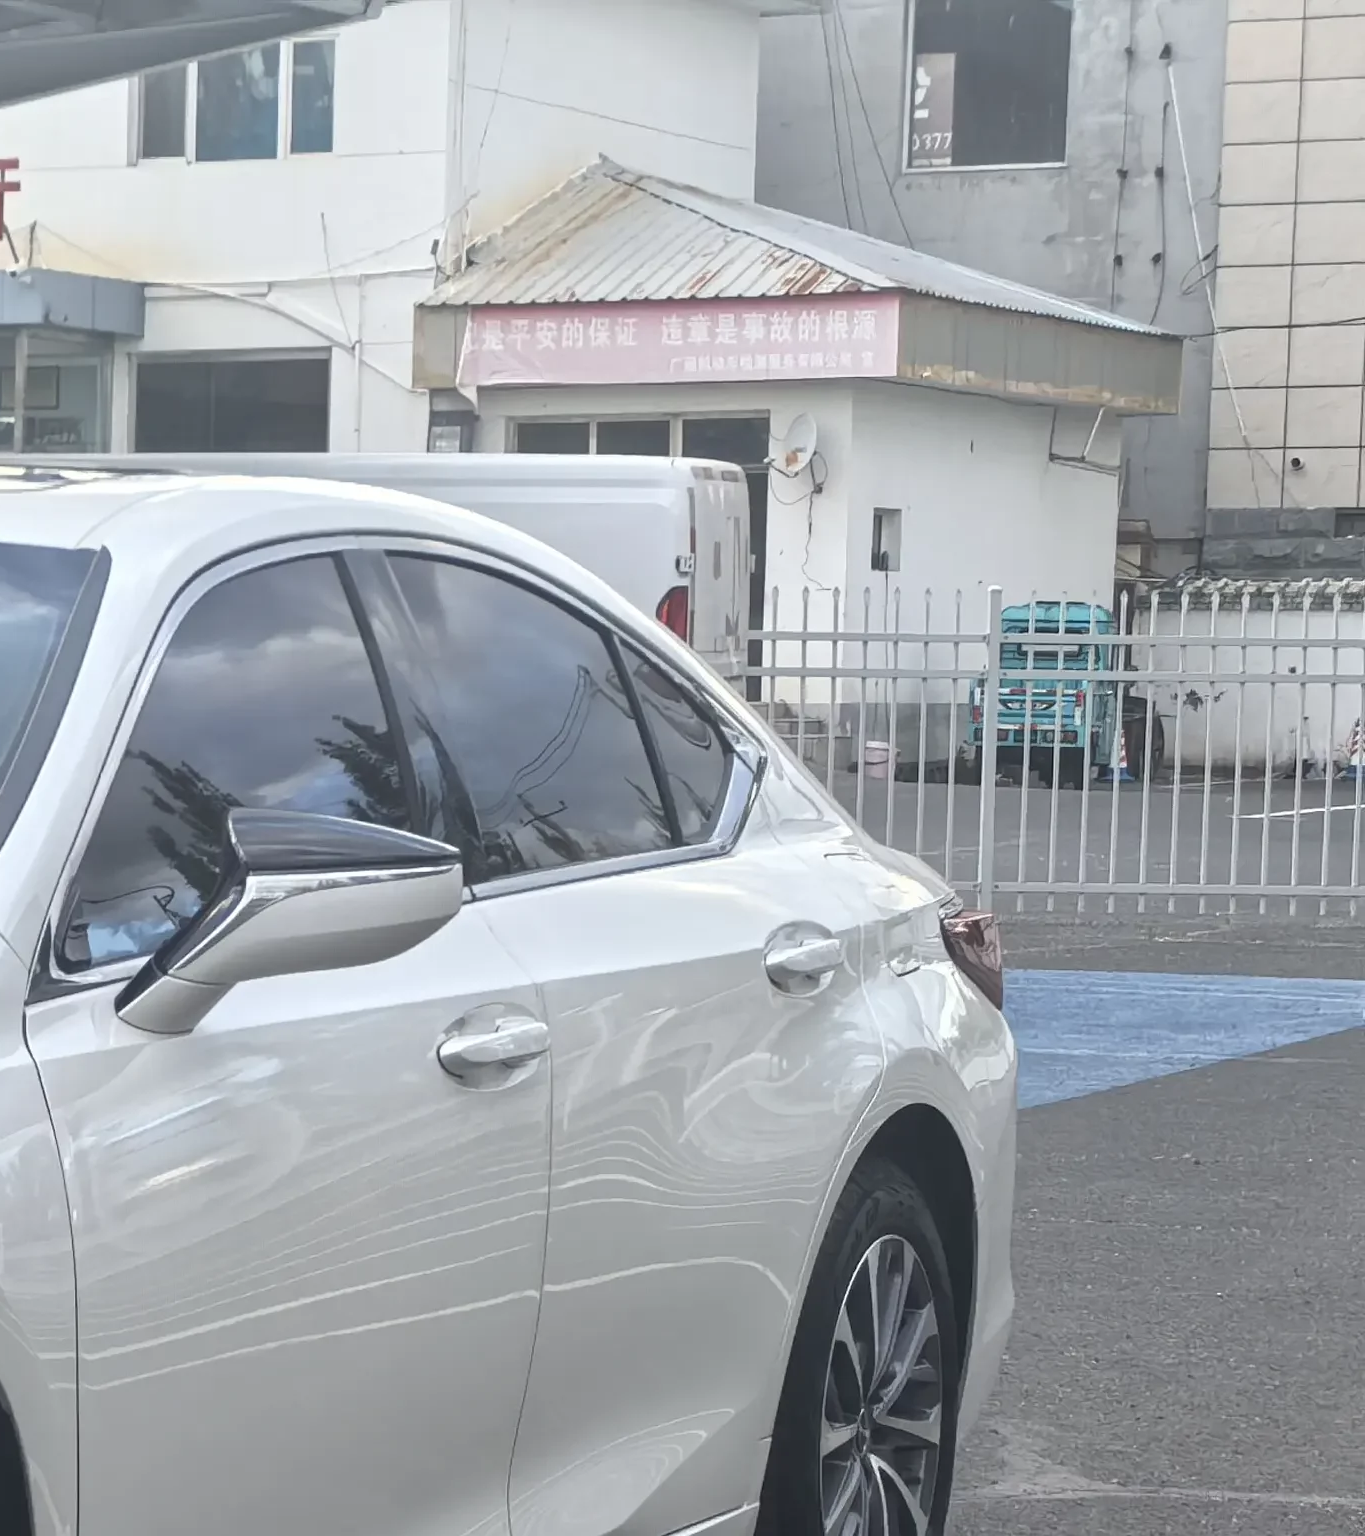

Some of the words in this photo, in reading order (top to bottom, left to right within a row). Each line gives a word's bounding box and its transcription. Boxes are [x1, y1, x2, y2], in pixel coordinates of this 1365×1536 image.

[660, 308, 879, 346] 违章是事故的根源
